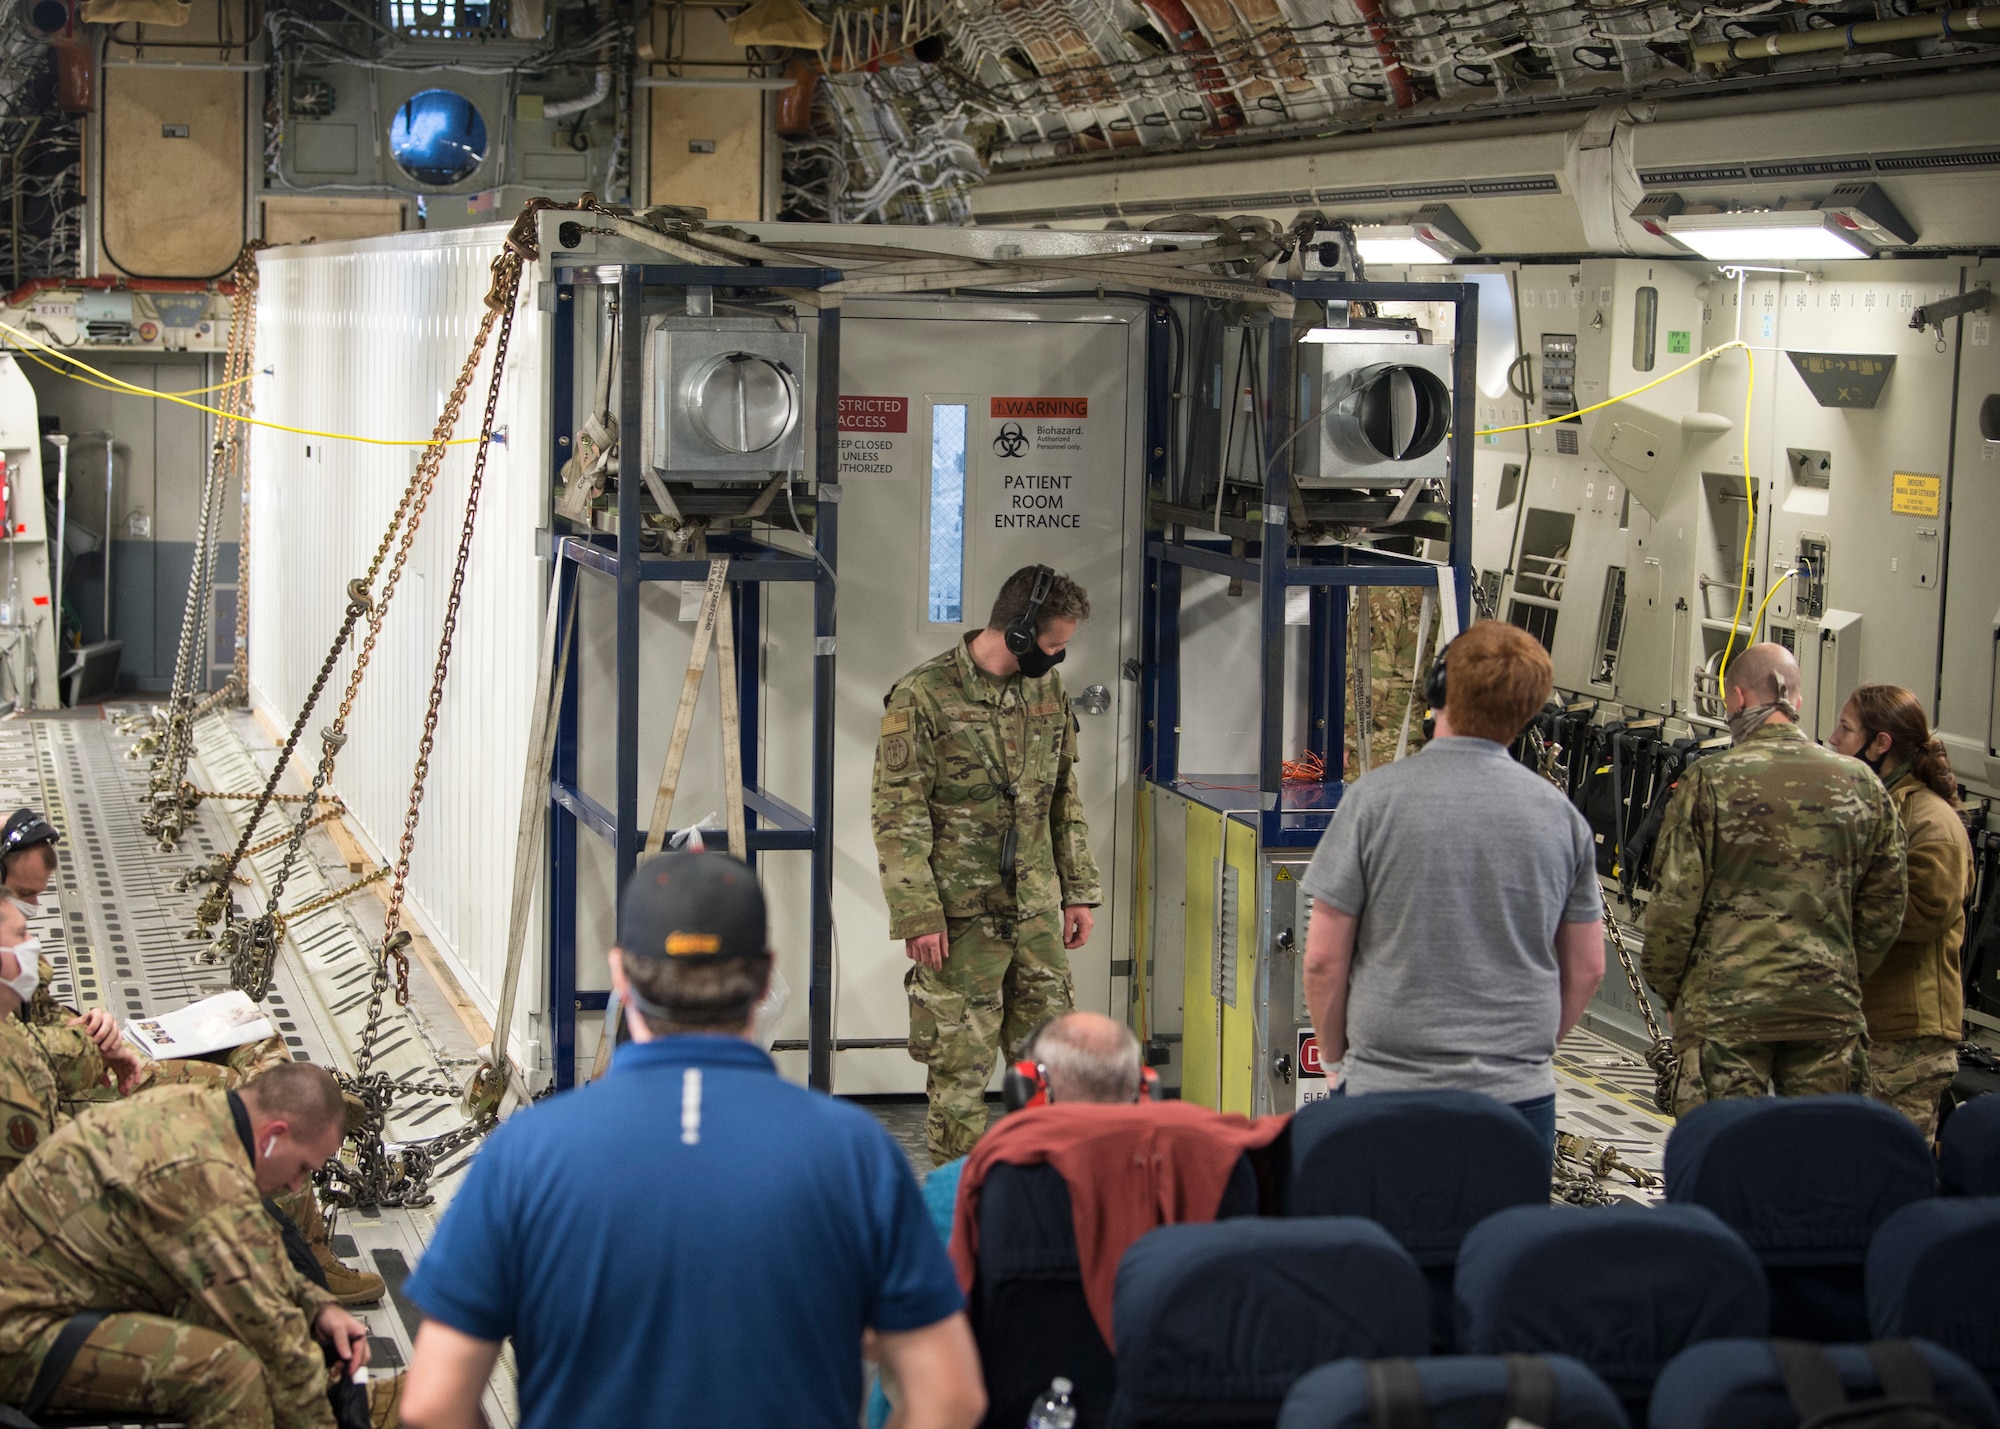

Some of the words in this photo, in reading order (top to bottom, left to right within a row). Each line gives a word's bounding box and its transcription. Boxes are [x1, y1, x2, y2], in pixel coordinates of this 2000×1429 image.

[41, 305, 70, 315] EXIT
[1671, 331, 1681, 339] PP
[1672, 345, 1685, 353] 807
[838, 399, 902, 413] STRICTED
[1006, 401, 1087, 415] WARNING
[838, 415, 887, 428] ACCESS
[1037, 425, 1084, 435] Biohazard.
[837, 440, 853, 449] EEP
[854, 440, 893, 450] CLOSED
[842, 452, 879, 461] UNLESS
[837, 463, 893, 474] UTHORIZED
[1004, 475, 1073, 489] PATIENT
[1012, 495, 1063, 509] ROOM
[995, 514, 1081, 528] ENTRANCE
